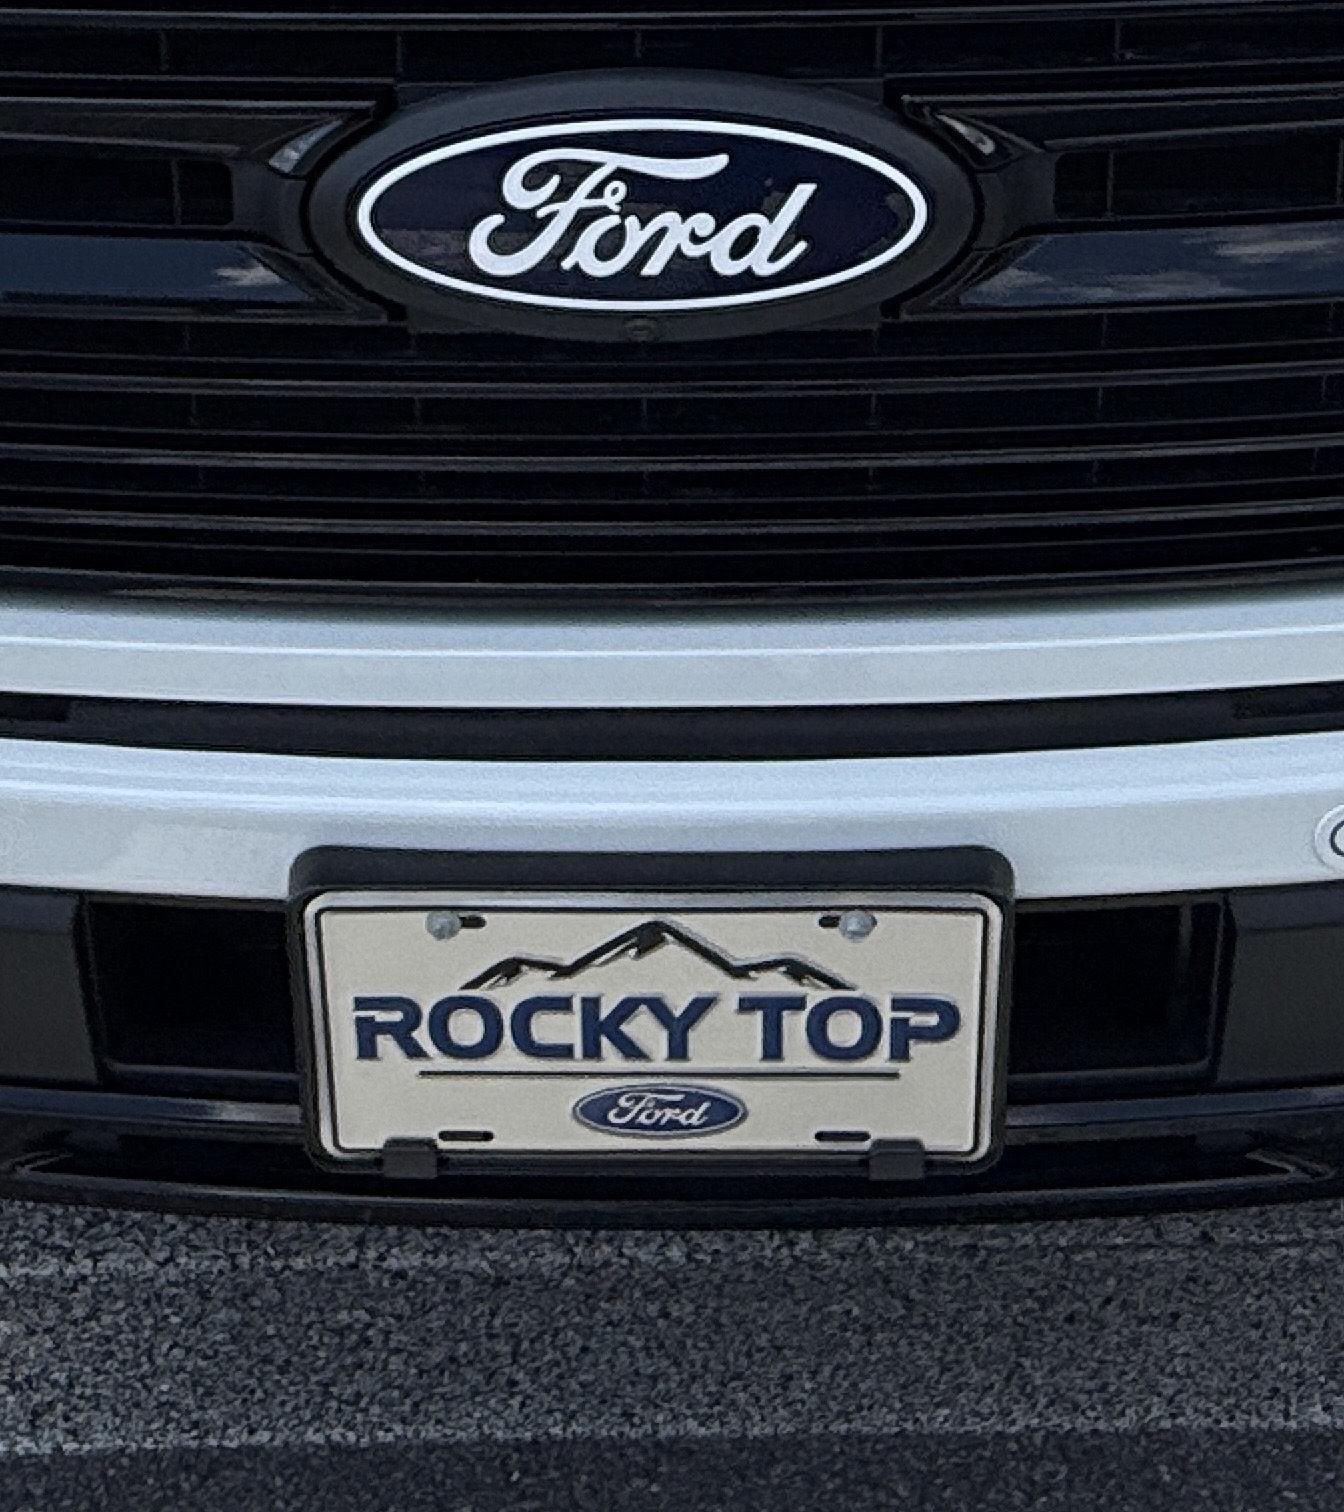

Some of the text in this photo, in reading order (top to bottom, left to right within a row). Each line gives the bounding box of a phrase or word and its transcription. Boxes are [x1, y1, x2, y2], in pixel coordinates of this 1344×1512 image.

[468, 148, 818, 277] Ford
[353, 995, 961, 1061] ROCKY TOP
[607, 1091, 712, 1126] Ford
